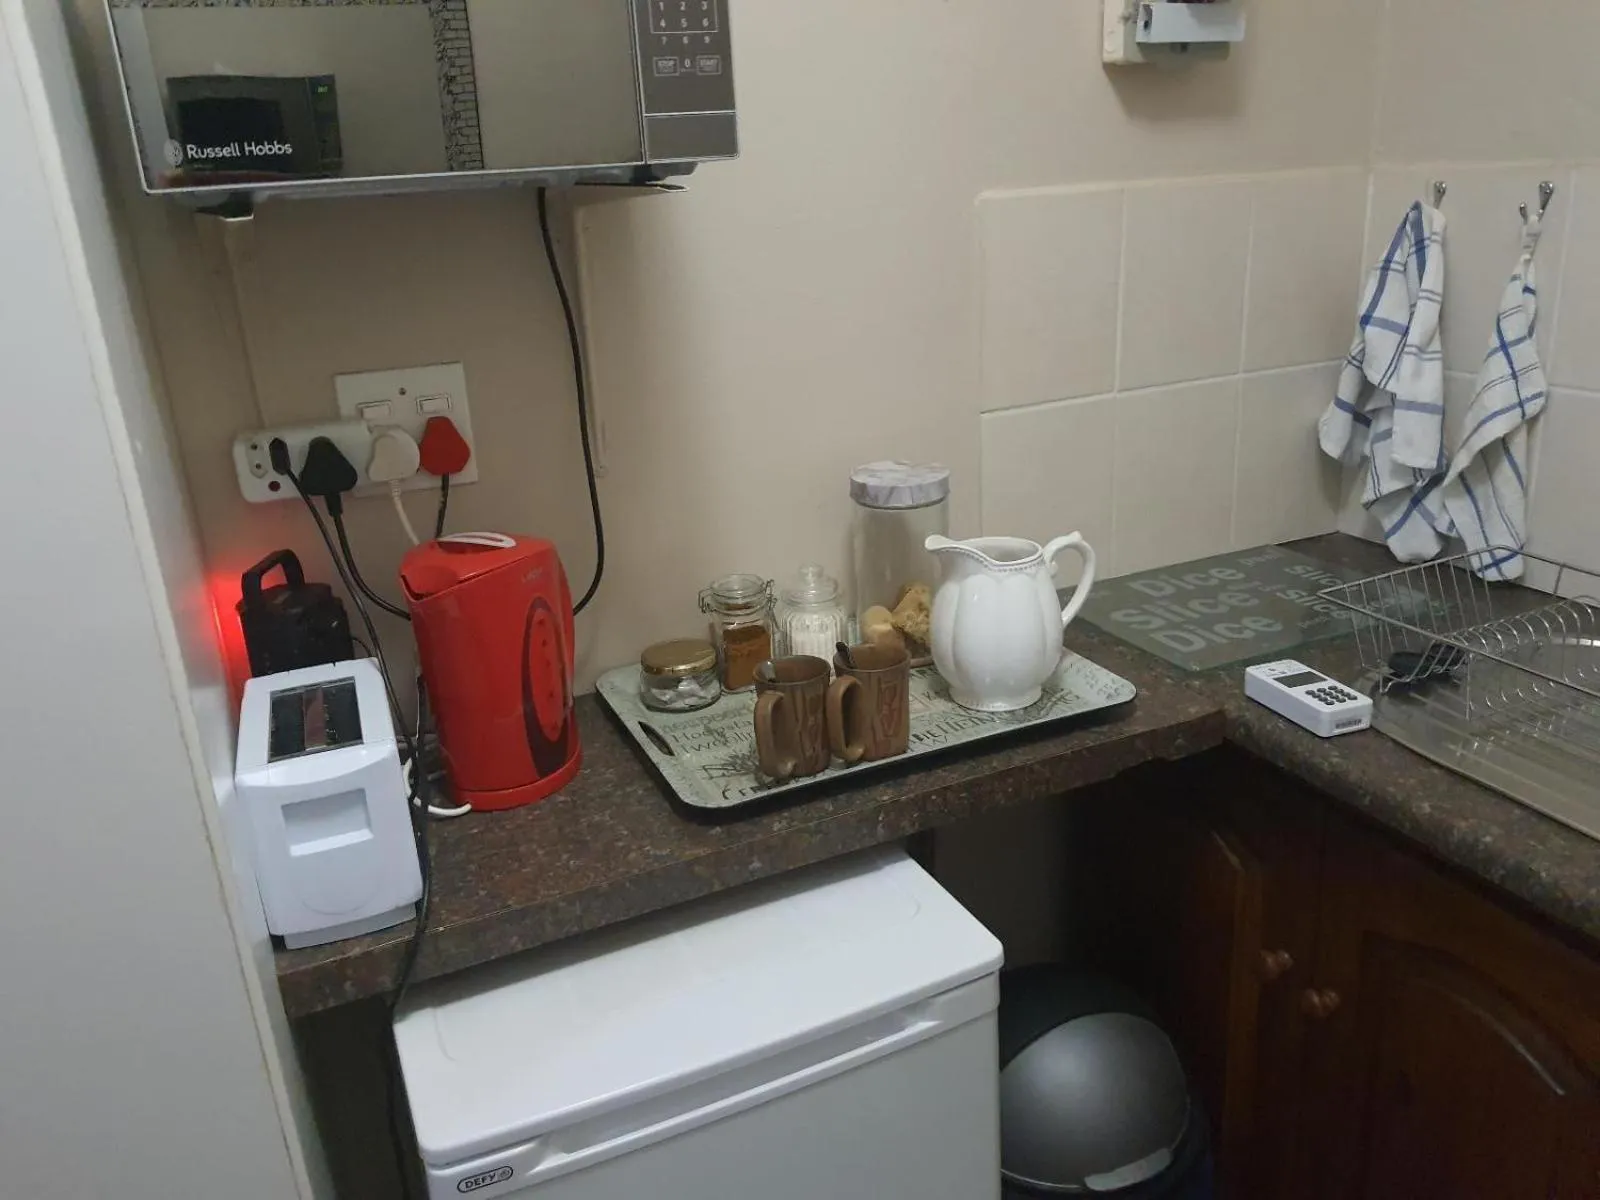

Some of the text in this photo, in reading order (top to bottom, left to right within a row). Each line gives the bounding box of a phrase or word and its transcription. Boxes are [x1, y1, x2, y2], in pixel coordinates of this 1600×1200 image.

[679, 1, 686, 11] 2
[701, 1, 708, 11] 3
[660, 18, 709, 28] 4 5 6
[684, 58, 691, 68] 0
[186, 140, 293, 160] Russell Hobbs
[1131, 567, 1246, 598] Dice
[1112, 591, 1260, 630] Slice
[1150, 616, 1283, 653] Dice
[465, 1173, 496, 1189] DEFY
